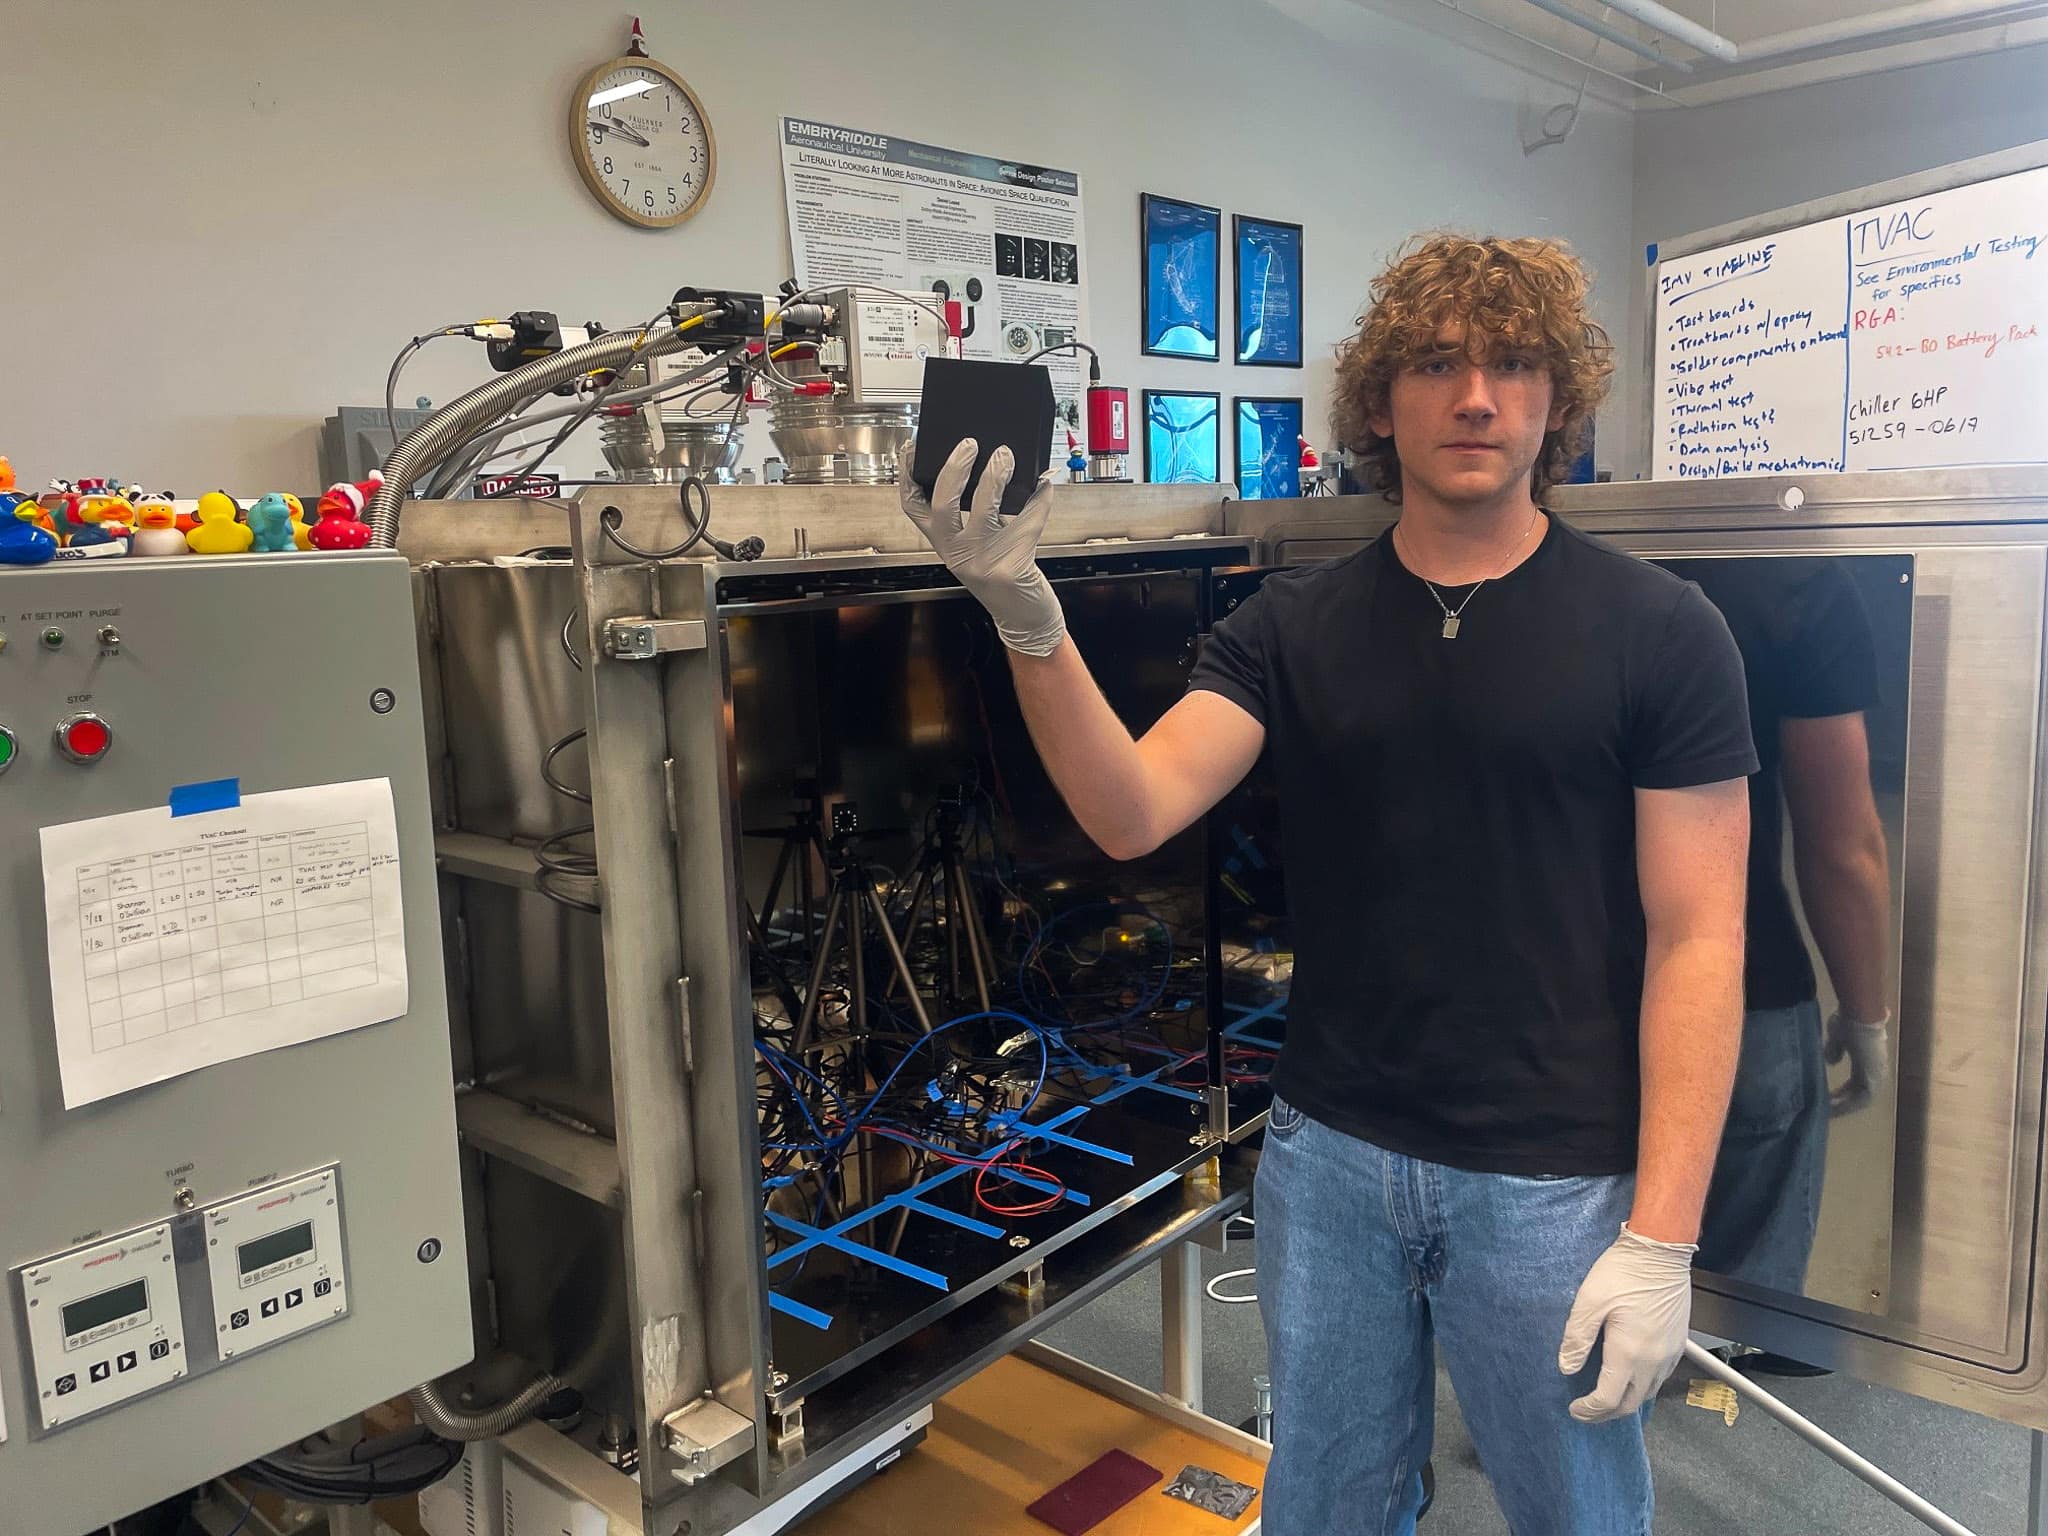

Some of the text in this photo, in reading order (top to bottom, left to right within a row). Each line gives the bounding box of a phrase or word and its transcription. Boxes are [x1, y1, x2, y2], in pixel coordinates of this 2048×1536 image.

[598, 102, 612, 119] 10
[665, 95, 672, 113] 1
[681, 117, 690, 134] 2
[788, 121, 888, 149] EMBRY-RIDDLE
[592, 126, 603, 145] 9
[689, 146, 698, 163] 3
[790, 134, 887, 161] Aeronautical University
[603, 156, 614, 175] 8
[622, 178, 630, 195] 7
[682, 172, 692, 188] 4
[644, 190, 655, 208] 6
[667, 187, 677, 204] 5
[1854, 207, 1935, 254] TVAC
[1703, 244, 1777, 278] TIMELINE
[1855, 234, 2048, 287] See Environmental Testing
[1872, 273, 1962, 303] for specifics
[1676, 298, 1755, 332] Test boards
[1946, 331, 2005, 359] Battery
[2008, 324, 2038, 343] Pack
[1676, 355, 1719, 374] Solder
[1721, 337, 1796, 367] components
[1709, 373, 1735, 394] test
[1677, 391, 1755, 417] Thermal test
[1678, 420, 1737, 440] Radiation
[1679, 437, 1769, 458] Data analysis
[21, 610, 83, 621] AT SET POINT
[89, 608, 121, 618] PURGE
[67, 694, 93, 704] STOP
[166, 1162, 194, 1178] TURBO
[174, 1177, 187, 1187] ON
